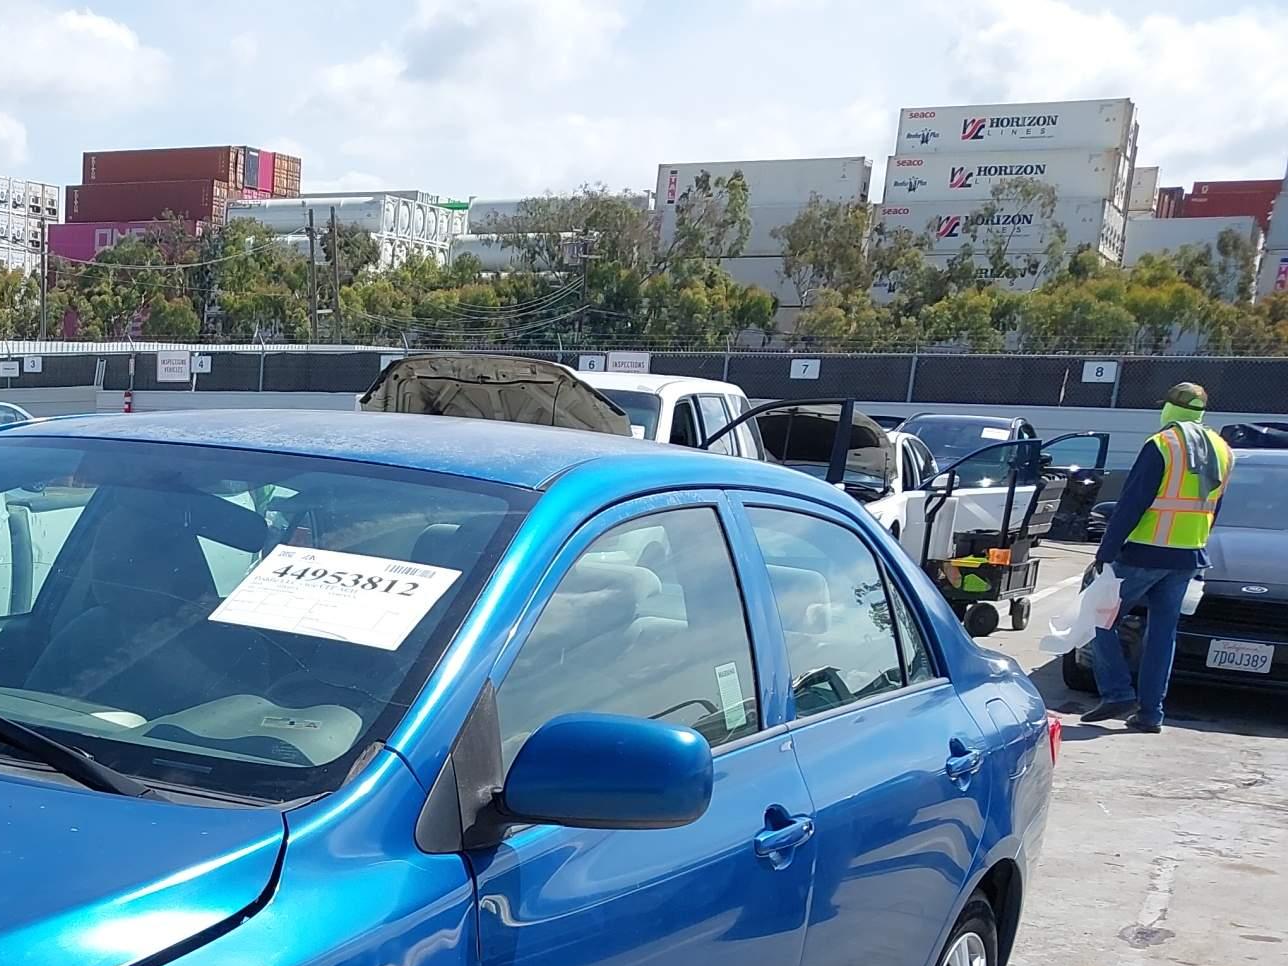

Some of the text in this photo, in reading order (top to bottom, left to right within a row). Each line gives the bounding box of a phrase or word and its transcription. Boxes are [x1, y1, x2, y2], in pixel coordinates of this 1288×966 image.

[908, 111, 936, 119] seaco
[989, 115, 1059, 128] HORIZON
[987, 128, 1046, 137] LINES
[896, 159, 924, 167] seaco
[976, 164, 1047, 176] HORIZON
[882, 207, 910, 215] seaco
[31, 359, 36, 369] 3
[198, 359, 204, 369] 4
[588, 359, 595, 370] 6
[612, 360, 646, 369] INSPECTIONS
[802, 364, 809, 375] 7
[1095, 366, 1104, 378] 8
[271, 564, 420, 597] 44953812
